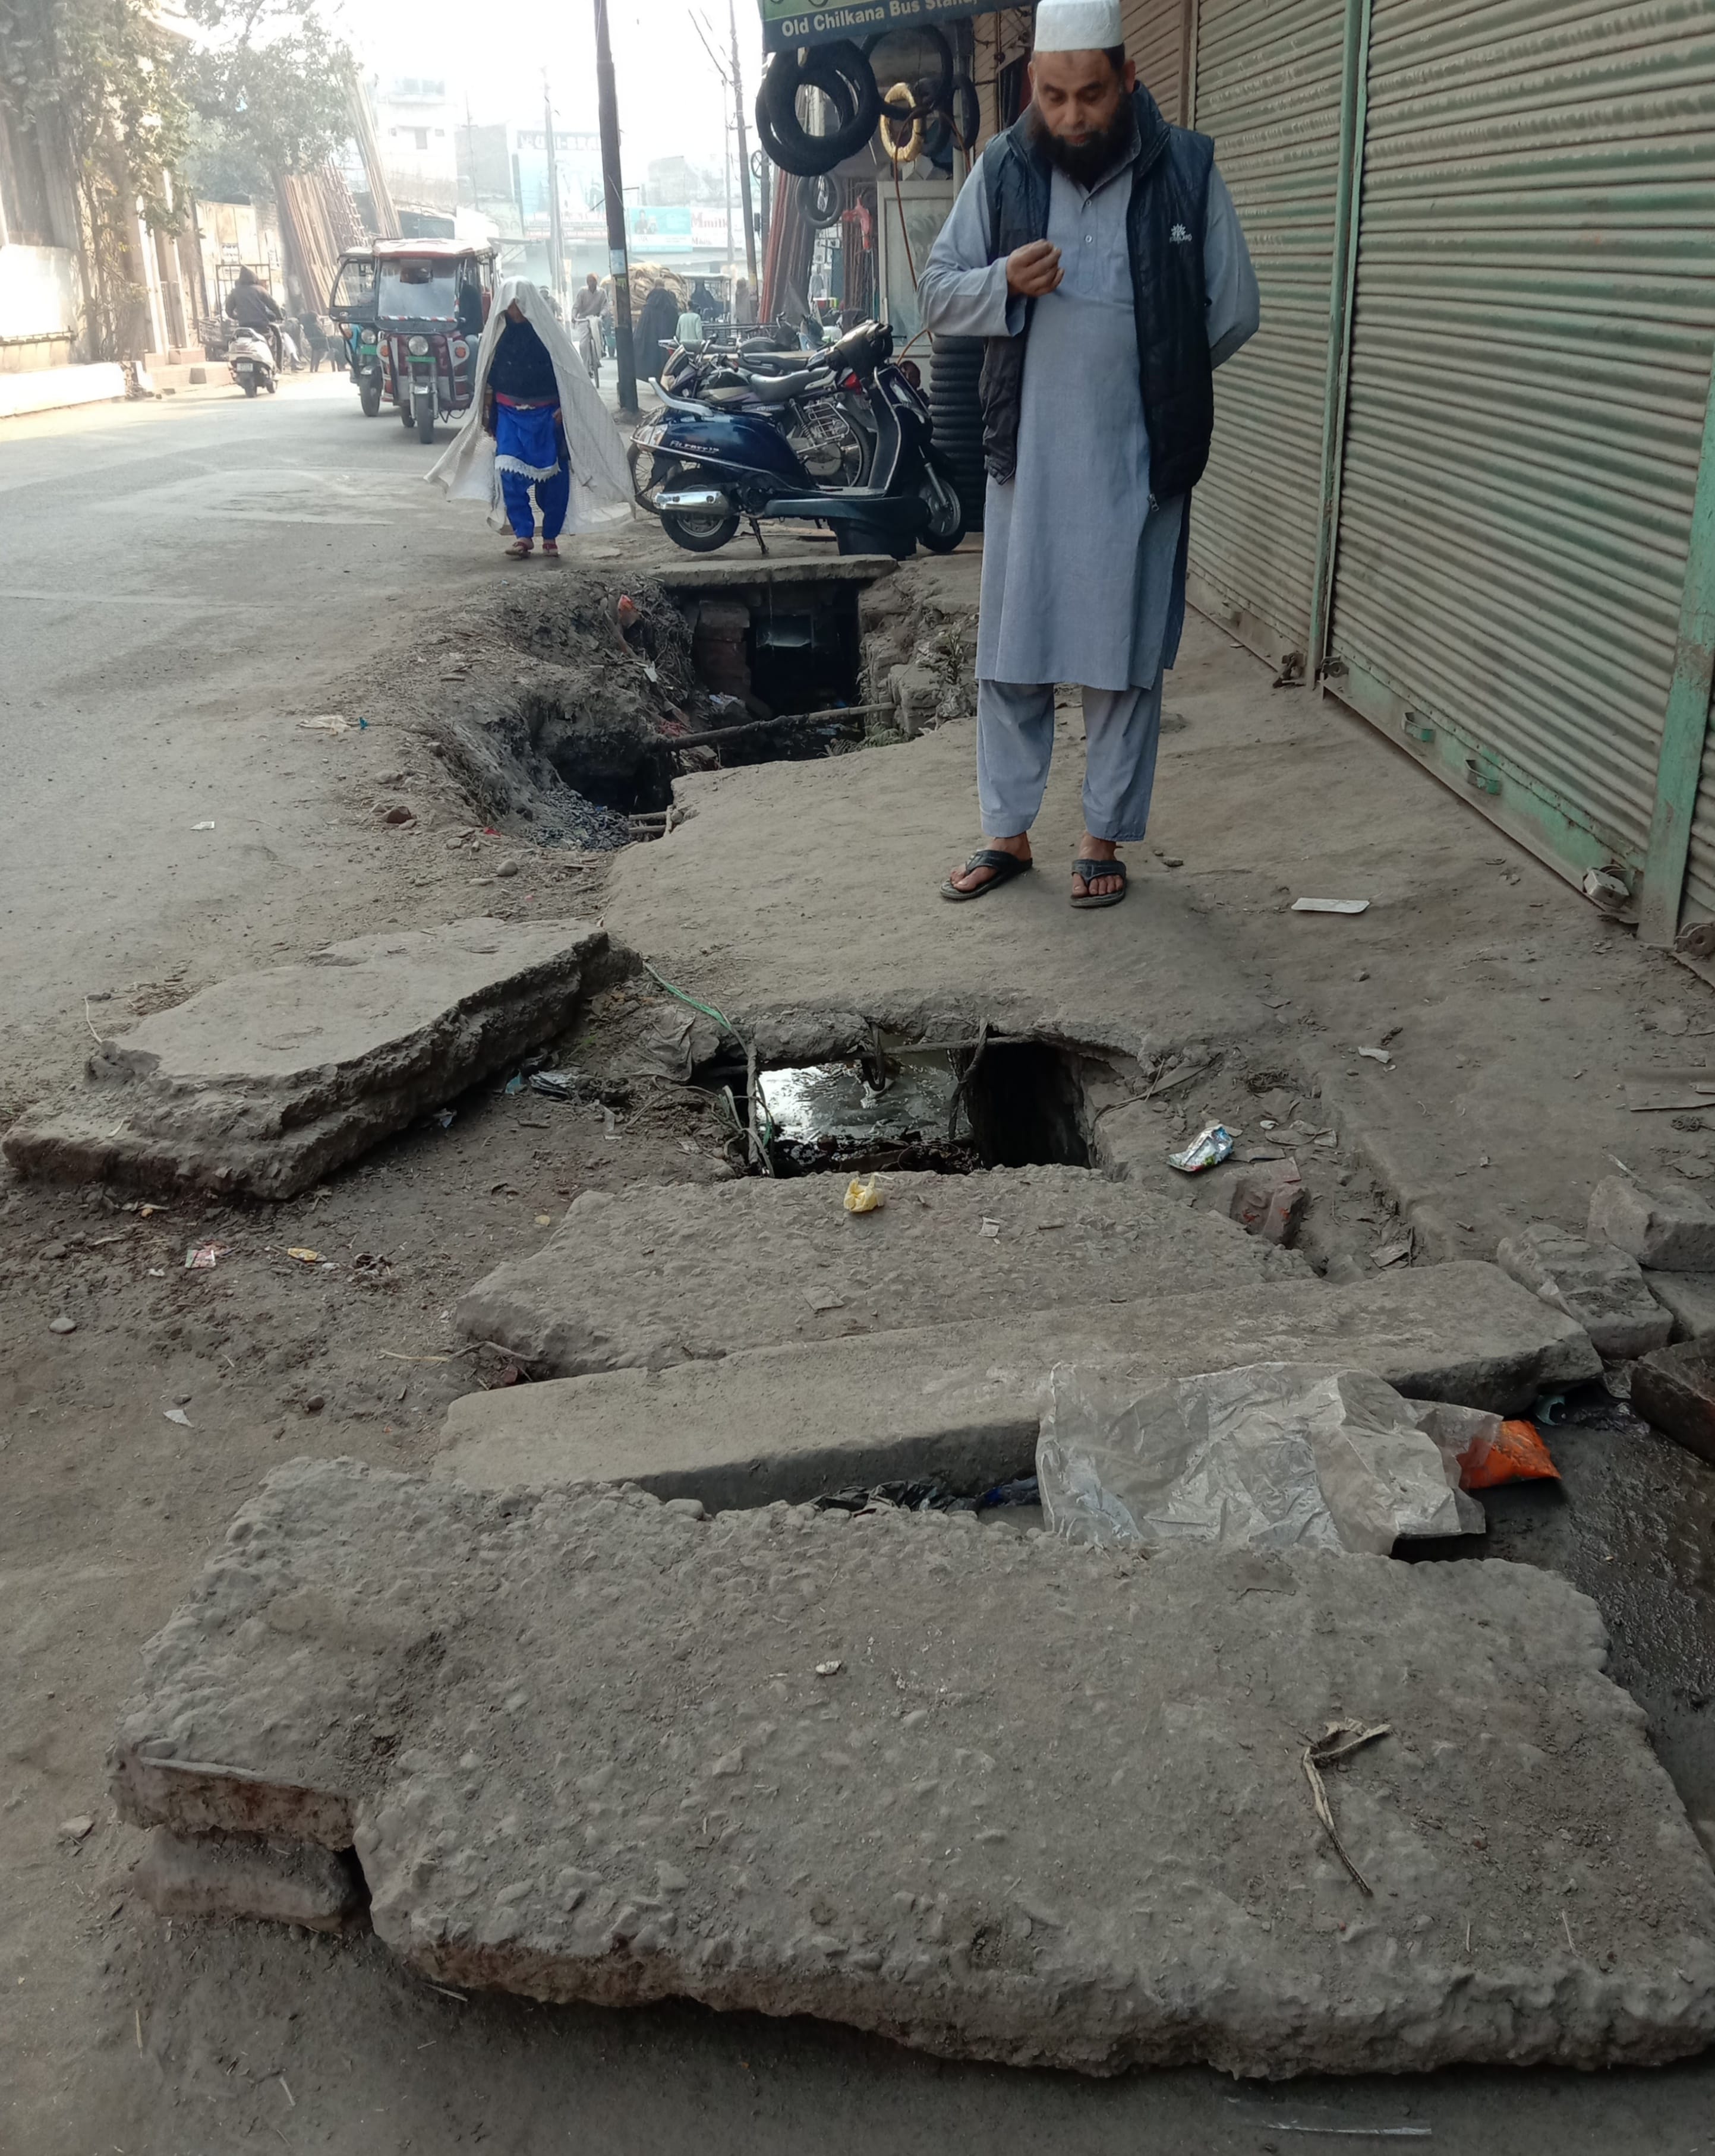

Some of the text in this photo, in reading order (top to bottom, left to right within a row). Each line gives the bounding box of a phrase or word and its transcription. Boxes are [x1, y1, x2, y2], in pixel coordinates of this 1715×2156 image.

[781, 0, 978, 37] Old Chilkana Bus Stan,
